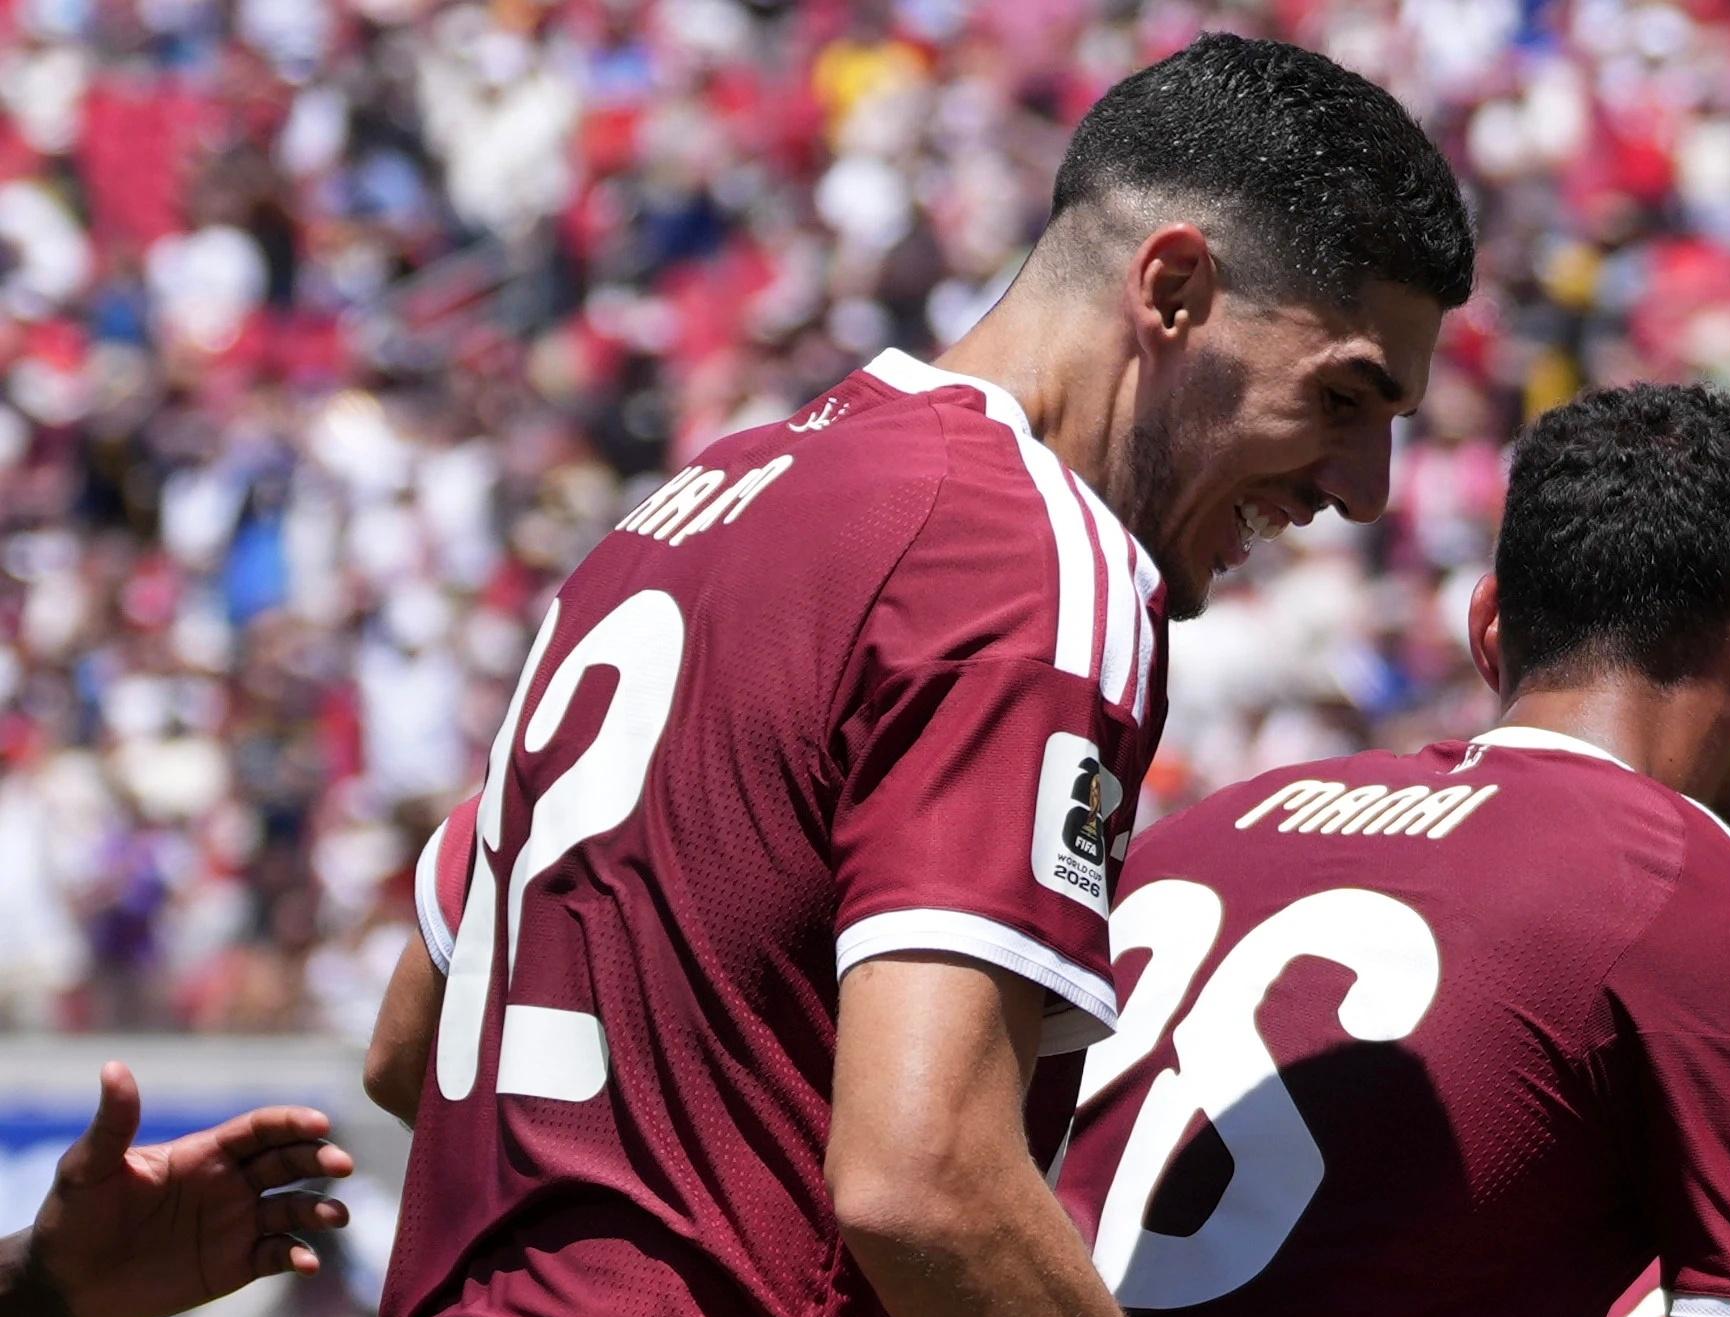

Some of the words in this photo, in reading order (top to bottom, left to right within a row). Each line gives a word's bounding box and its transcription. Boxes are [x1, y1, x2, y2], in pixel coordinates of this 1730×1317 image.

[1234, 780, 1498, 839] MANAI
[1075, 835, 1098, 857] FIFA
[1054, 864, 1101, 898] 2026
[1057, 853, 1088, 874] WORLD
[1088, 867, 1103, 883] CUP
